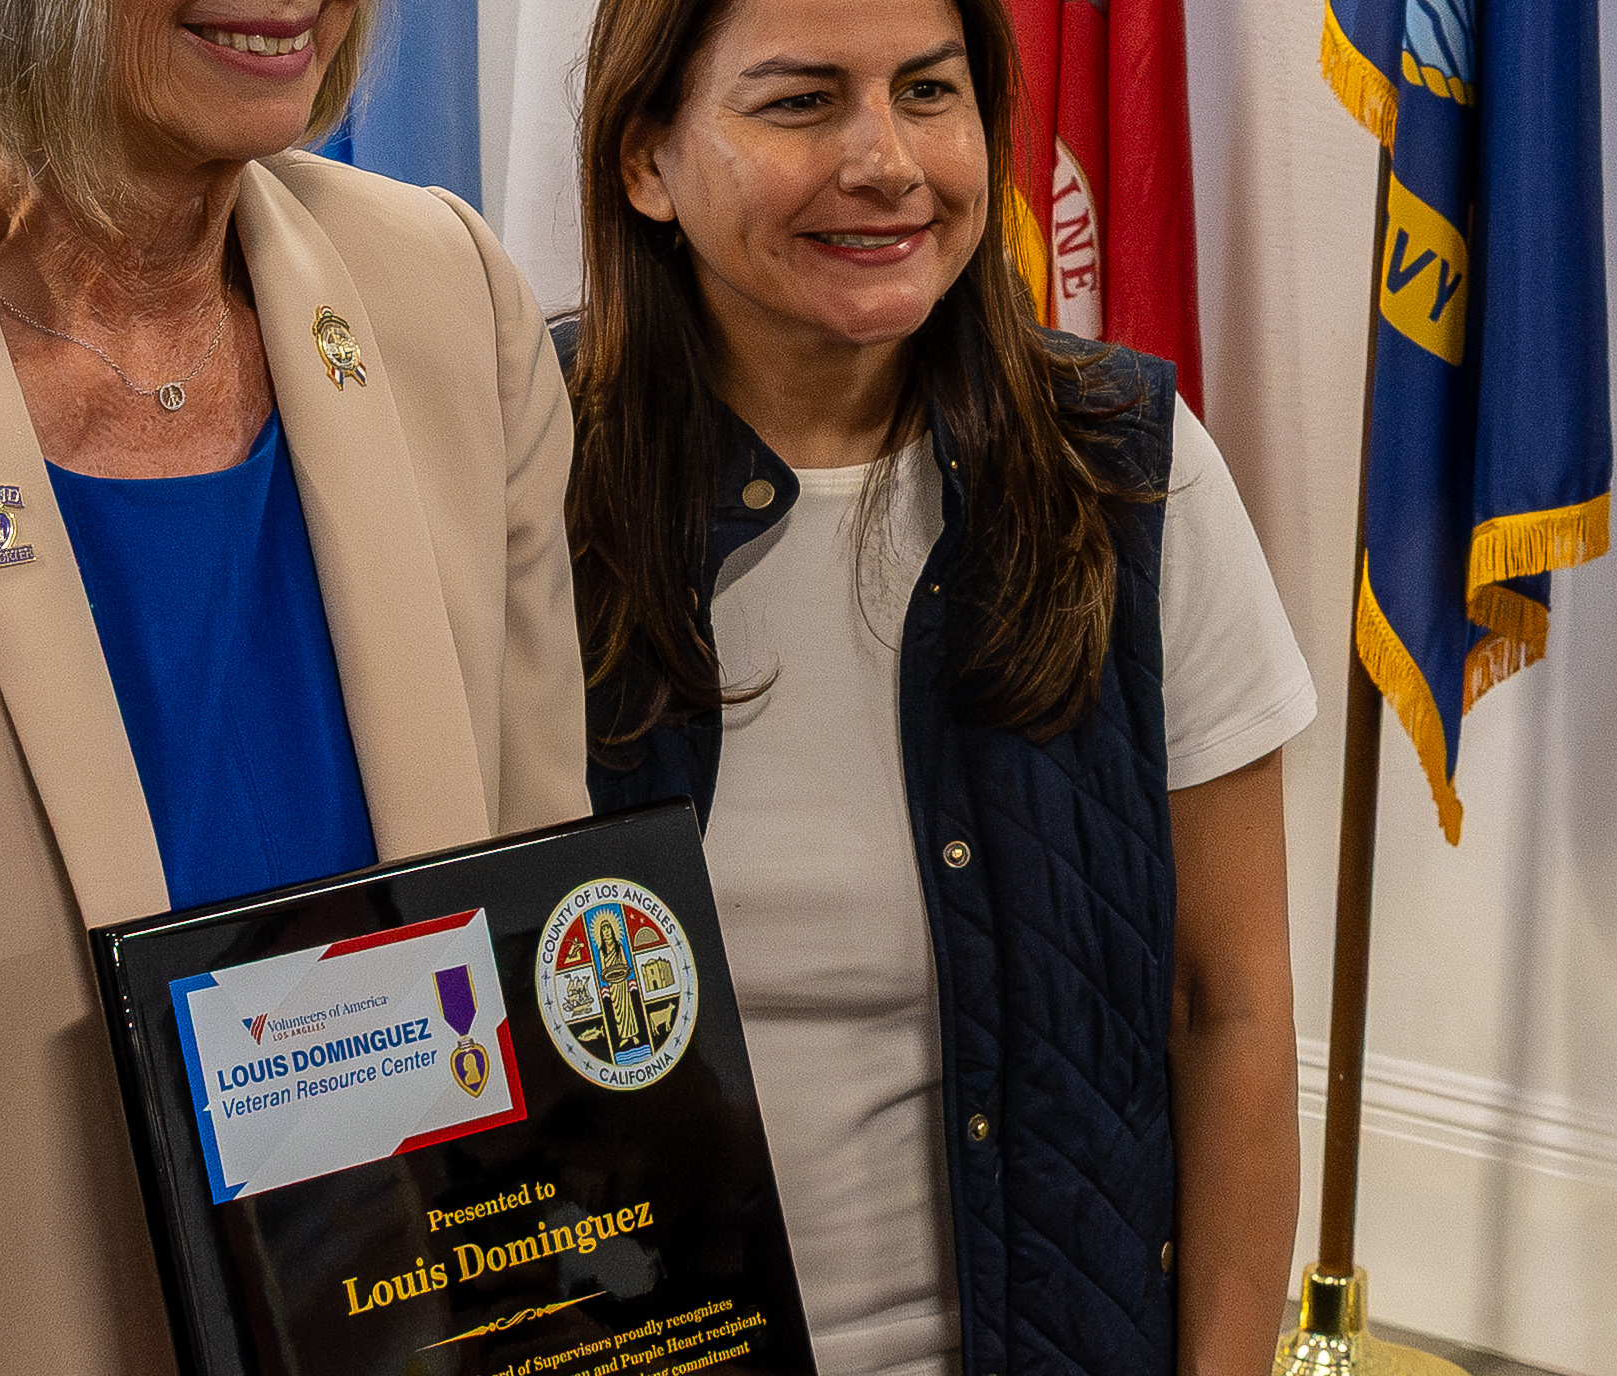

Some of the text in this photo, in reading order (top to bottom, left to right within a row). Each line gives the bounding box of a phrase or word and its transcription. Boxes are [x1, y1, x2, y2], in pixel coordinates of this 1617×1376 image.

[543, 884, 676, 964] COUNTY OF LOS ANGELES
[267, 994, 386, 1034] Volunteers of America
[272, 1031, 289, 1041] LOS
[217, 1017, 432, 1092] LOUIS DOMINGUEZ
[222, 1049, 438, 1119] Veteran Resource Center
[599, 1052, 675, 1085] CALIFORNIA
[427, 1182, 555, 1232] Presented to
[343, 1202, 653, 1315] Louis Dominguez
[517, 1358, 531, 1376] of
[533, 1337, 612, 1372] Supervisors
[613, 1319, 664, 1350] proudly
[665, 1299, 733, 1329] recognizes
[619, 1344, 665, 1369] Purple
[666, 1330, 705, 1354] Heart
[705, 1311, 767, 1341] recipient,
